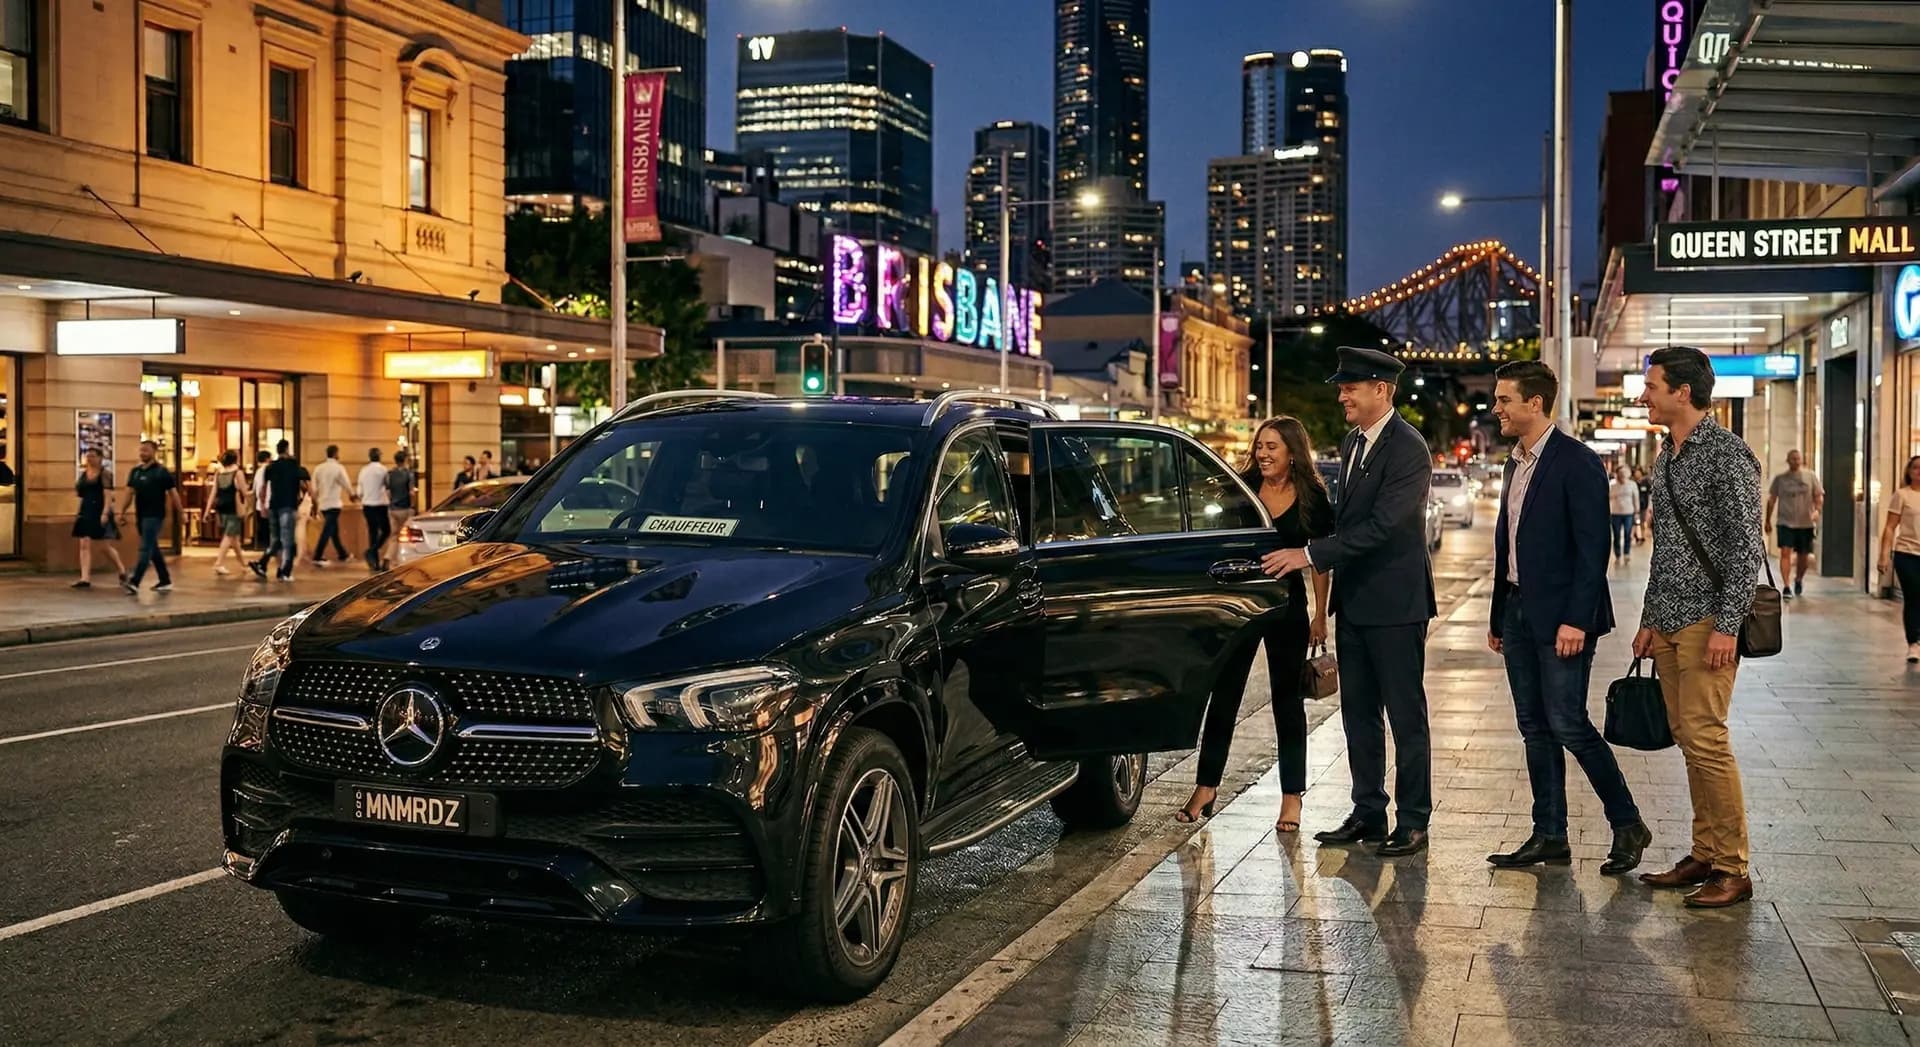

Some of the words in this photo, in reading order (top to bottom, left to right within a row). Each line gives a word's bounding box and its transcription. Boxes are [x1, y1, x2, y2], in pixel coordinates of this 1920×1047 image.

[1670, 231, 1746, 259] QUEEN
[1753, 228, 1842, 257] STREET
[1849, 226, 1916, 254] MALL
[833, 235, 1043, 357] BRISBANE
[648, 519, 727, 534] CHAUFFEUR
[366, 792, 460, 828] MNMRDZ
